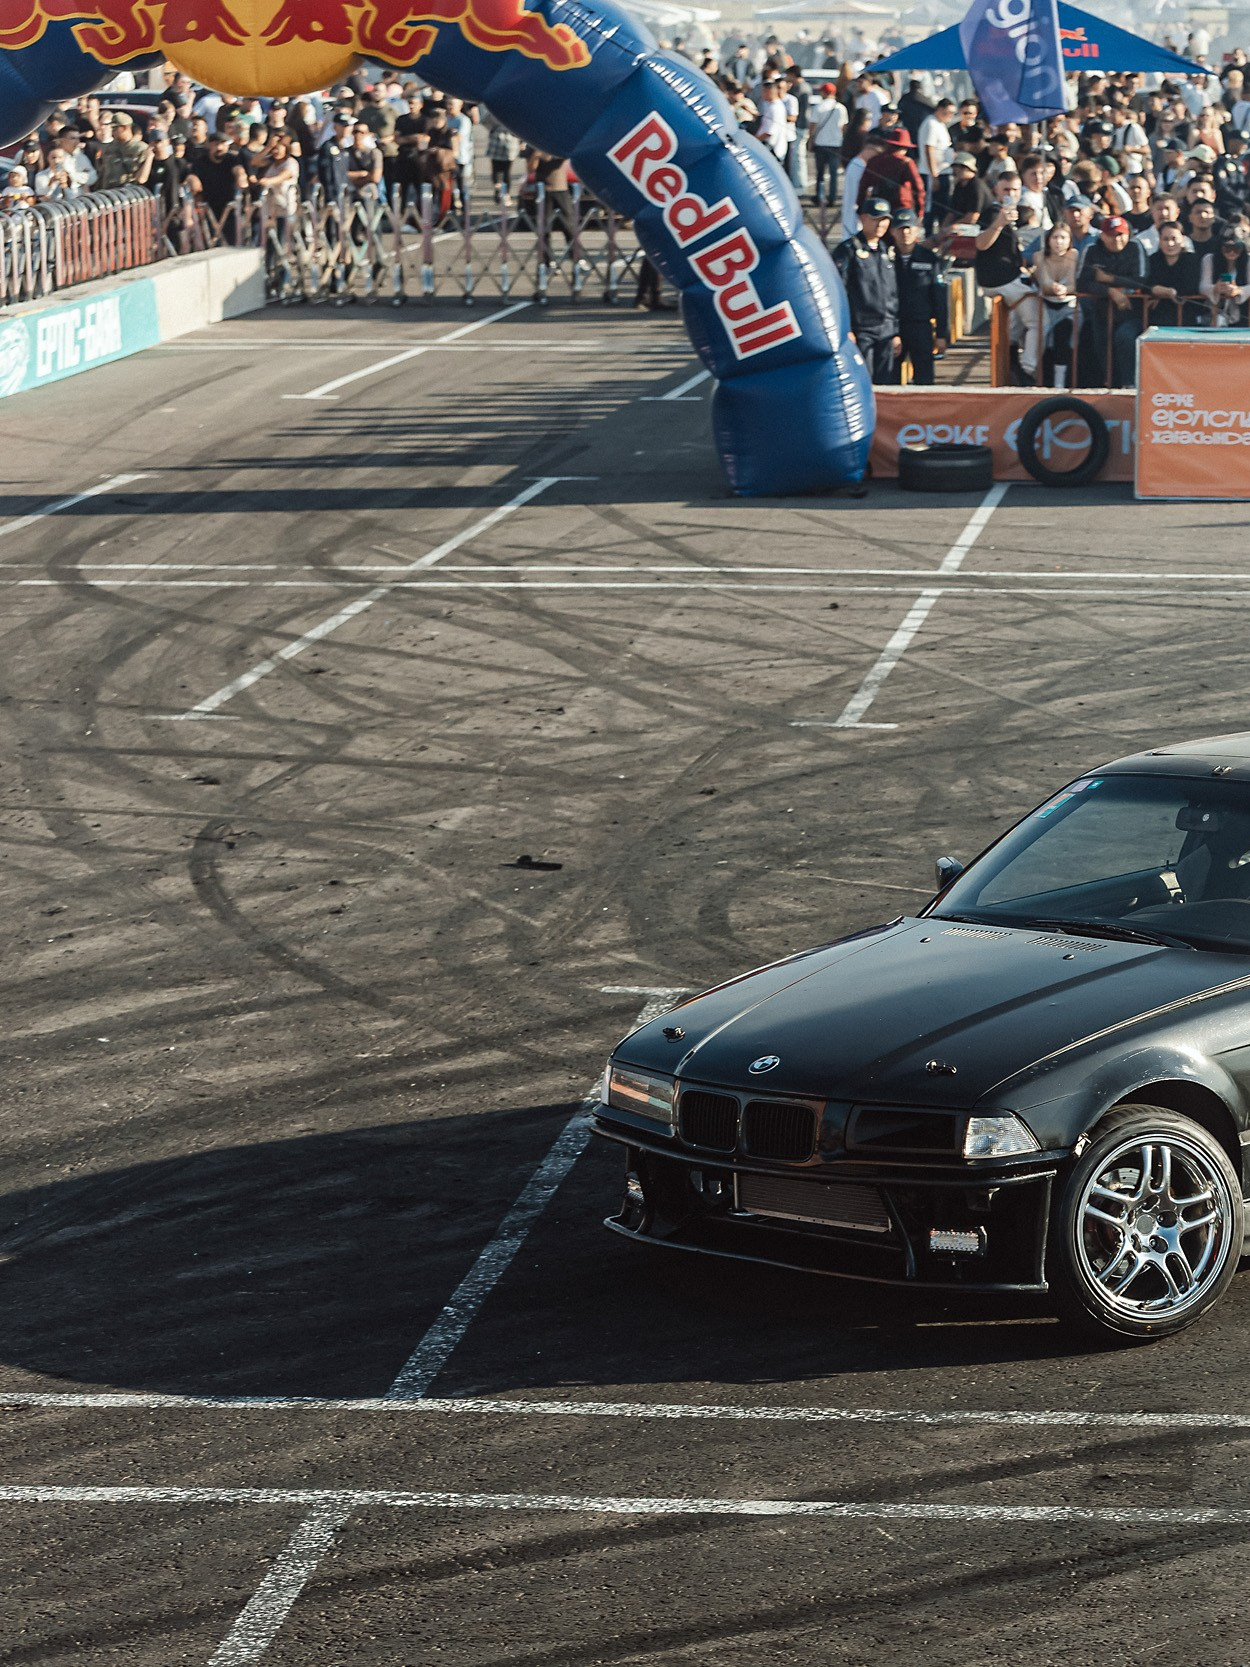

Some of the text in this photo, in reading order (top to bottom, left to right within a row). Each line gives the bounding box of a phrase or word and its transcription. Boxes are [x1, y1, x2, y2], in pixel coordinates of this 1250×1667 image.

[1061, 43, 1099, 58] ull
[608, 112, 800, 358] Red Bull
